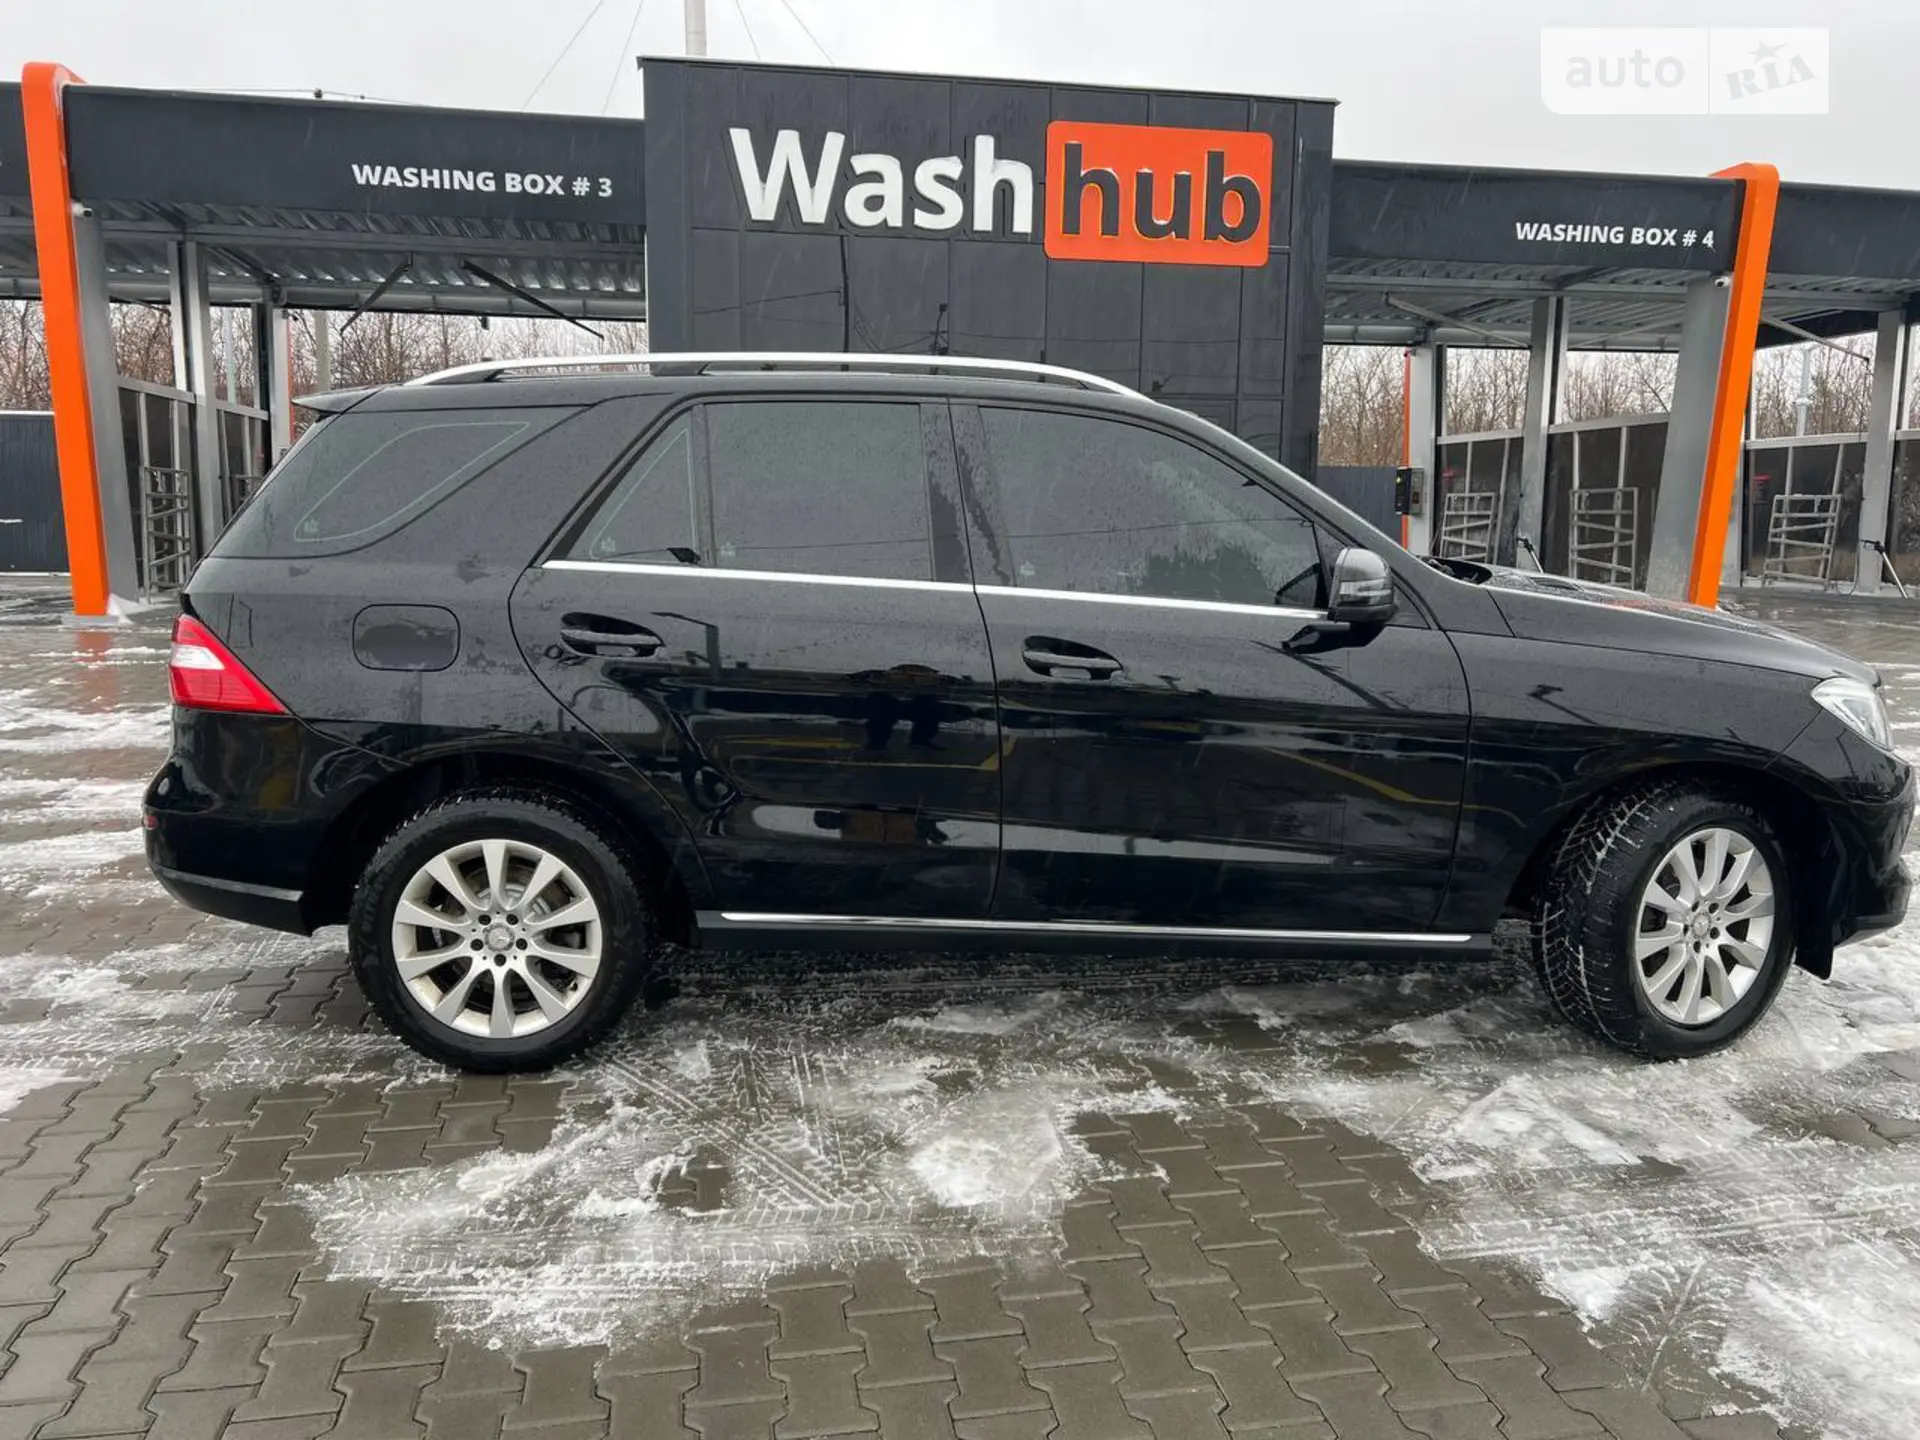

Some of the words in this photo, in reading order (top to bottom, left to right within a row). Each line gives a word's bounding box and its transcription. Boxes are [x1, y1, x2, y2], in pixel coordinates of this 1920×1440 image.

[351, 163, 497, 191] WASHING
[504, 172, 565, 196] BOX
[571, 176, 591, 196] #
[597, 177, 613, 198] 3
[729, 127, 1033, 233] Wash
[1062, 141, 1262, 243] hub
[1515, 221, 1625, 244] WASHING
[1630, 227, 1678, 247] BOX
[1682, 229, 1698, 247] #
[1701, 230, 1715, 248] 4
